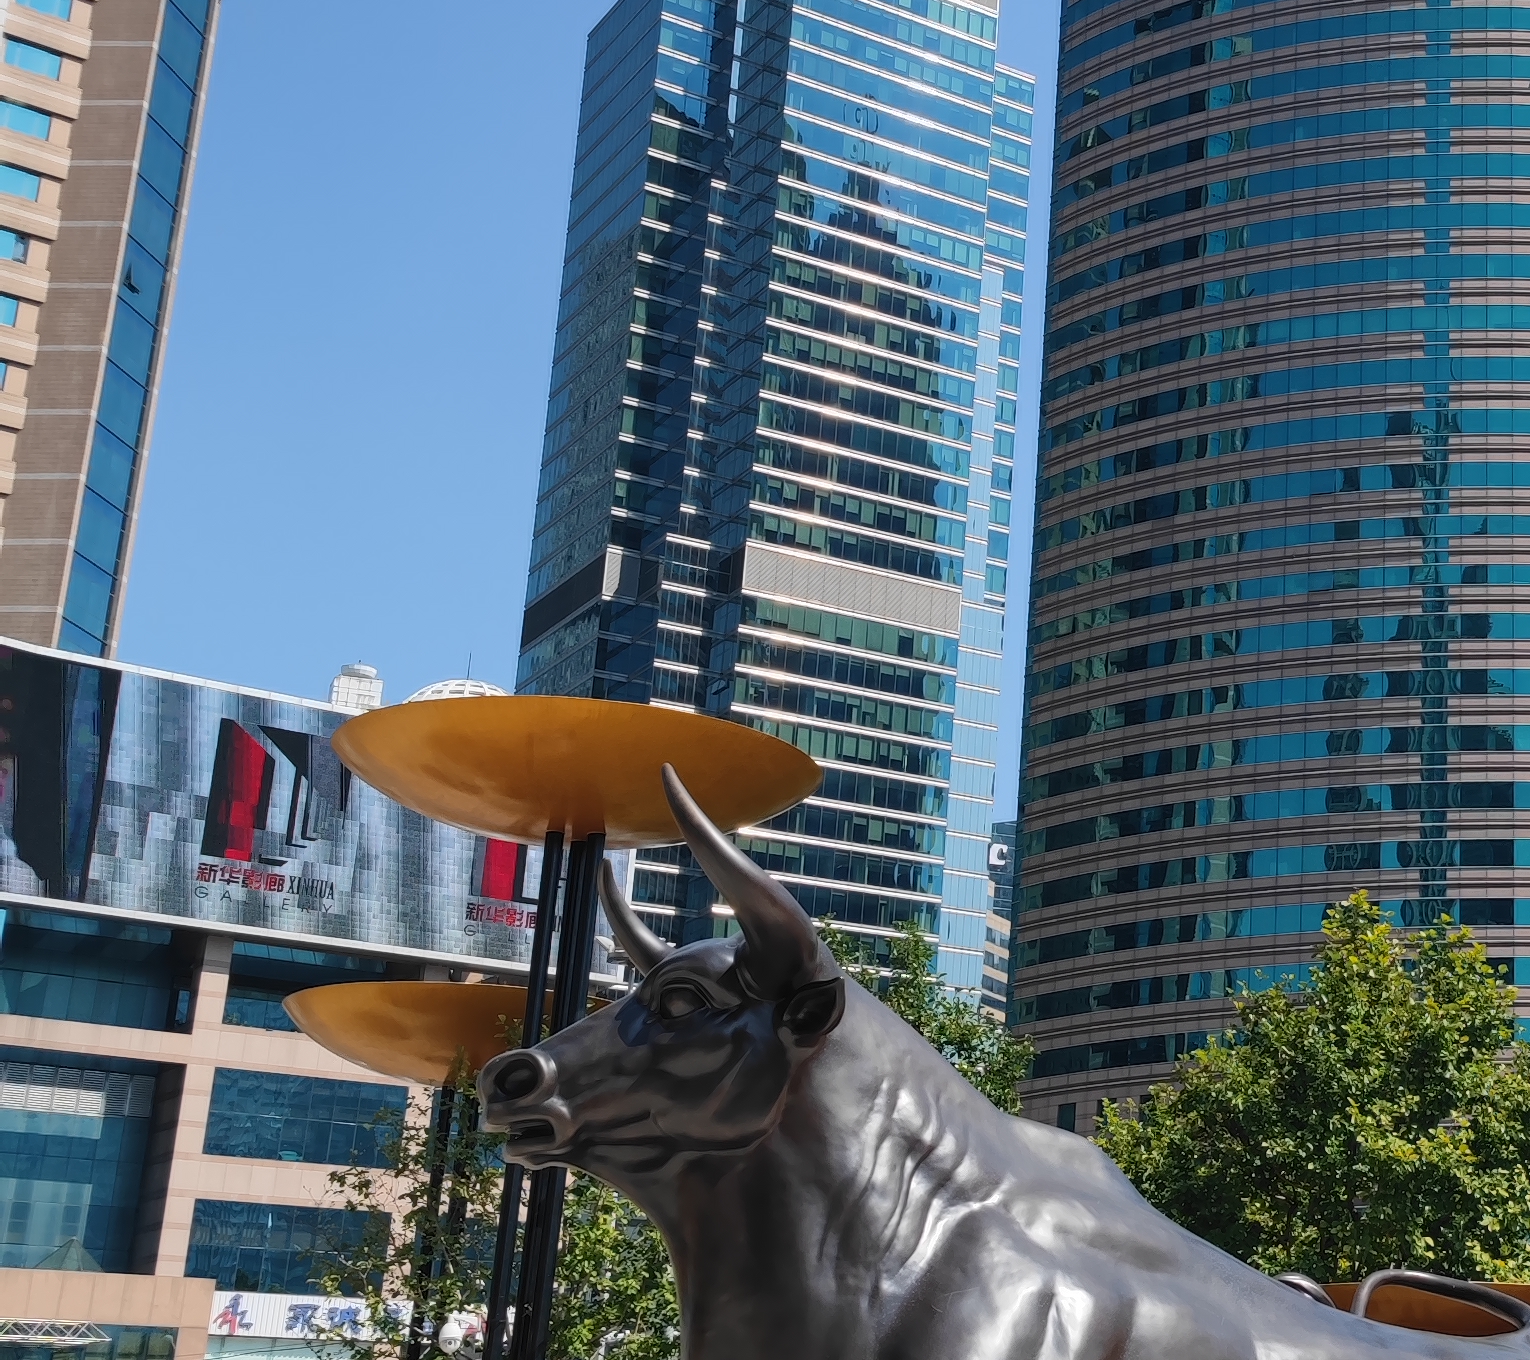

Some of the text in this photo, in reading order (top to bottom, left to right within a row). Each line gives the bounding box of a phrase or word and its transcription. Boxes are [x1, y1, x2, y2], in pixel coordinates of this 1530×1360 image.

[195, 862, 335, 901] 新华影廊 XINHUA
[194, 885, 333, 914] GALLERY
